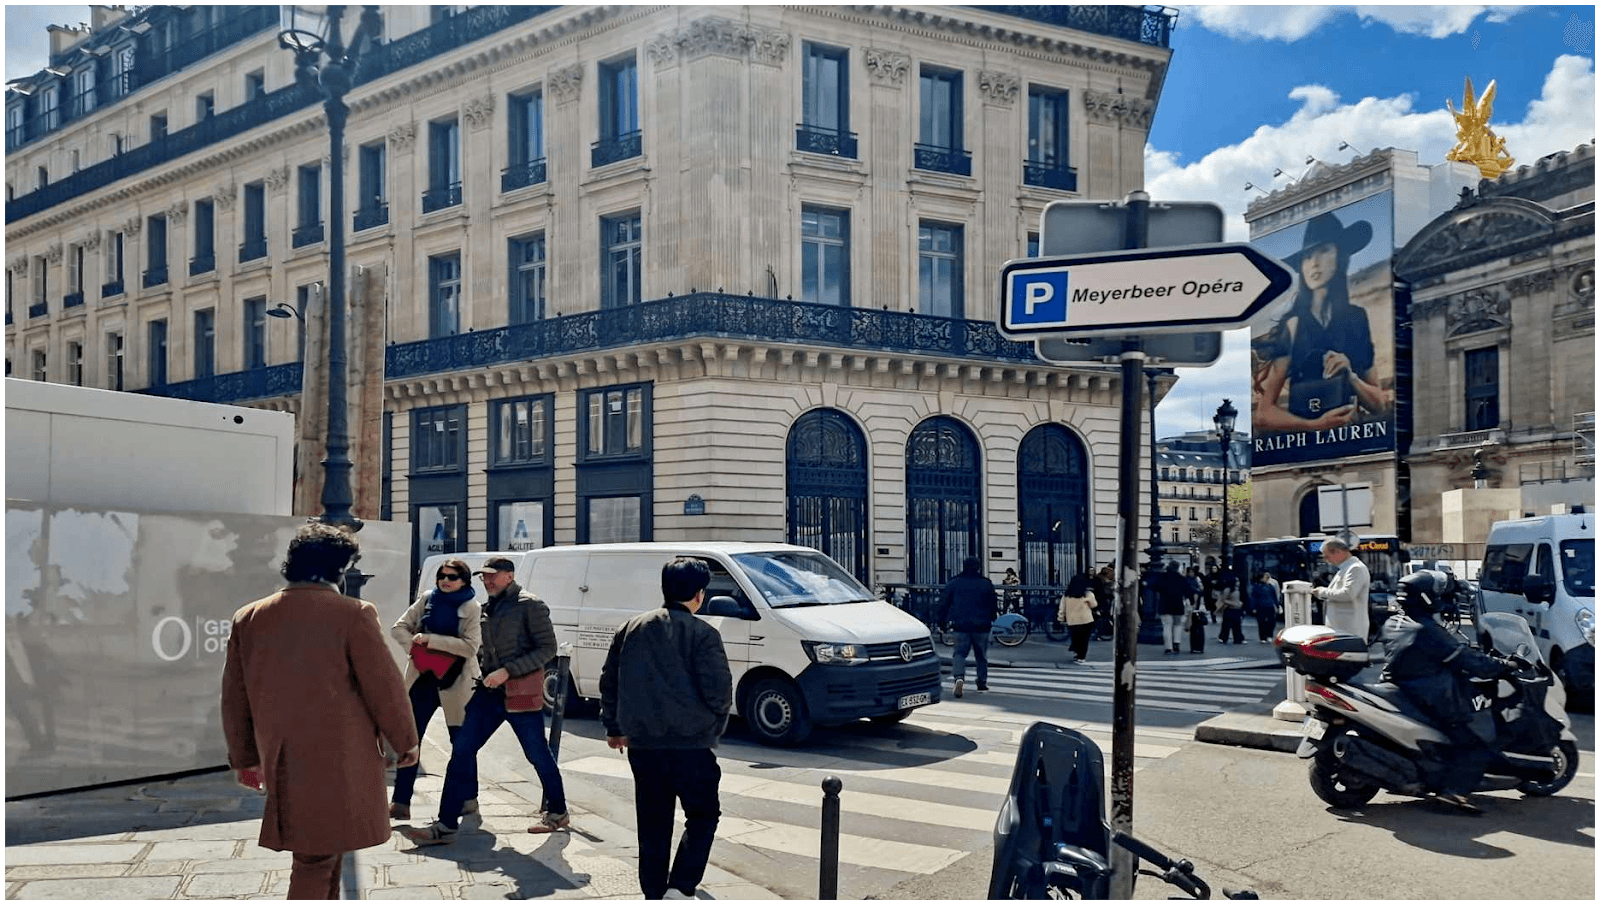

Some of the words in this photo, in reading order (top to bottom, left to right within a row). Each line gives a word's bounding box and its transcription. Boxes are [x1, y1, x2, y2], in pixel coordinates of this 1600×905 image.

[1024, 281, 1054, 315] P
[1072, 284, 1176, 305] Meyerbeer
[1181, 279, 1244, 298] Opéra
[1255, 432, 1306, 452] RALPH
[1315, 421, 1387, 445] LAUREN
[204, 620, 231, 635] GR
